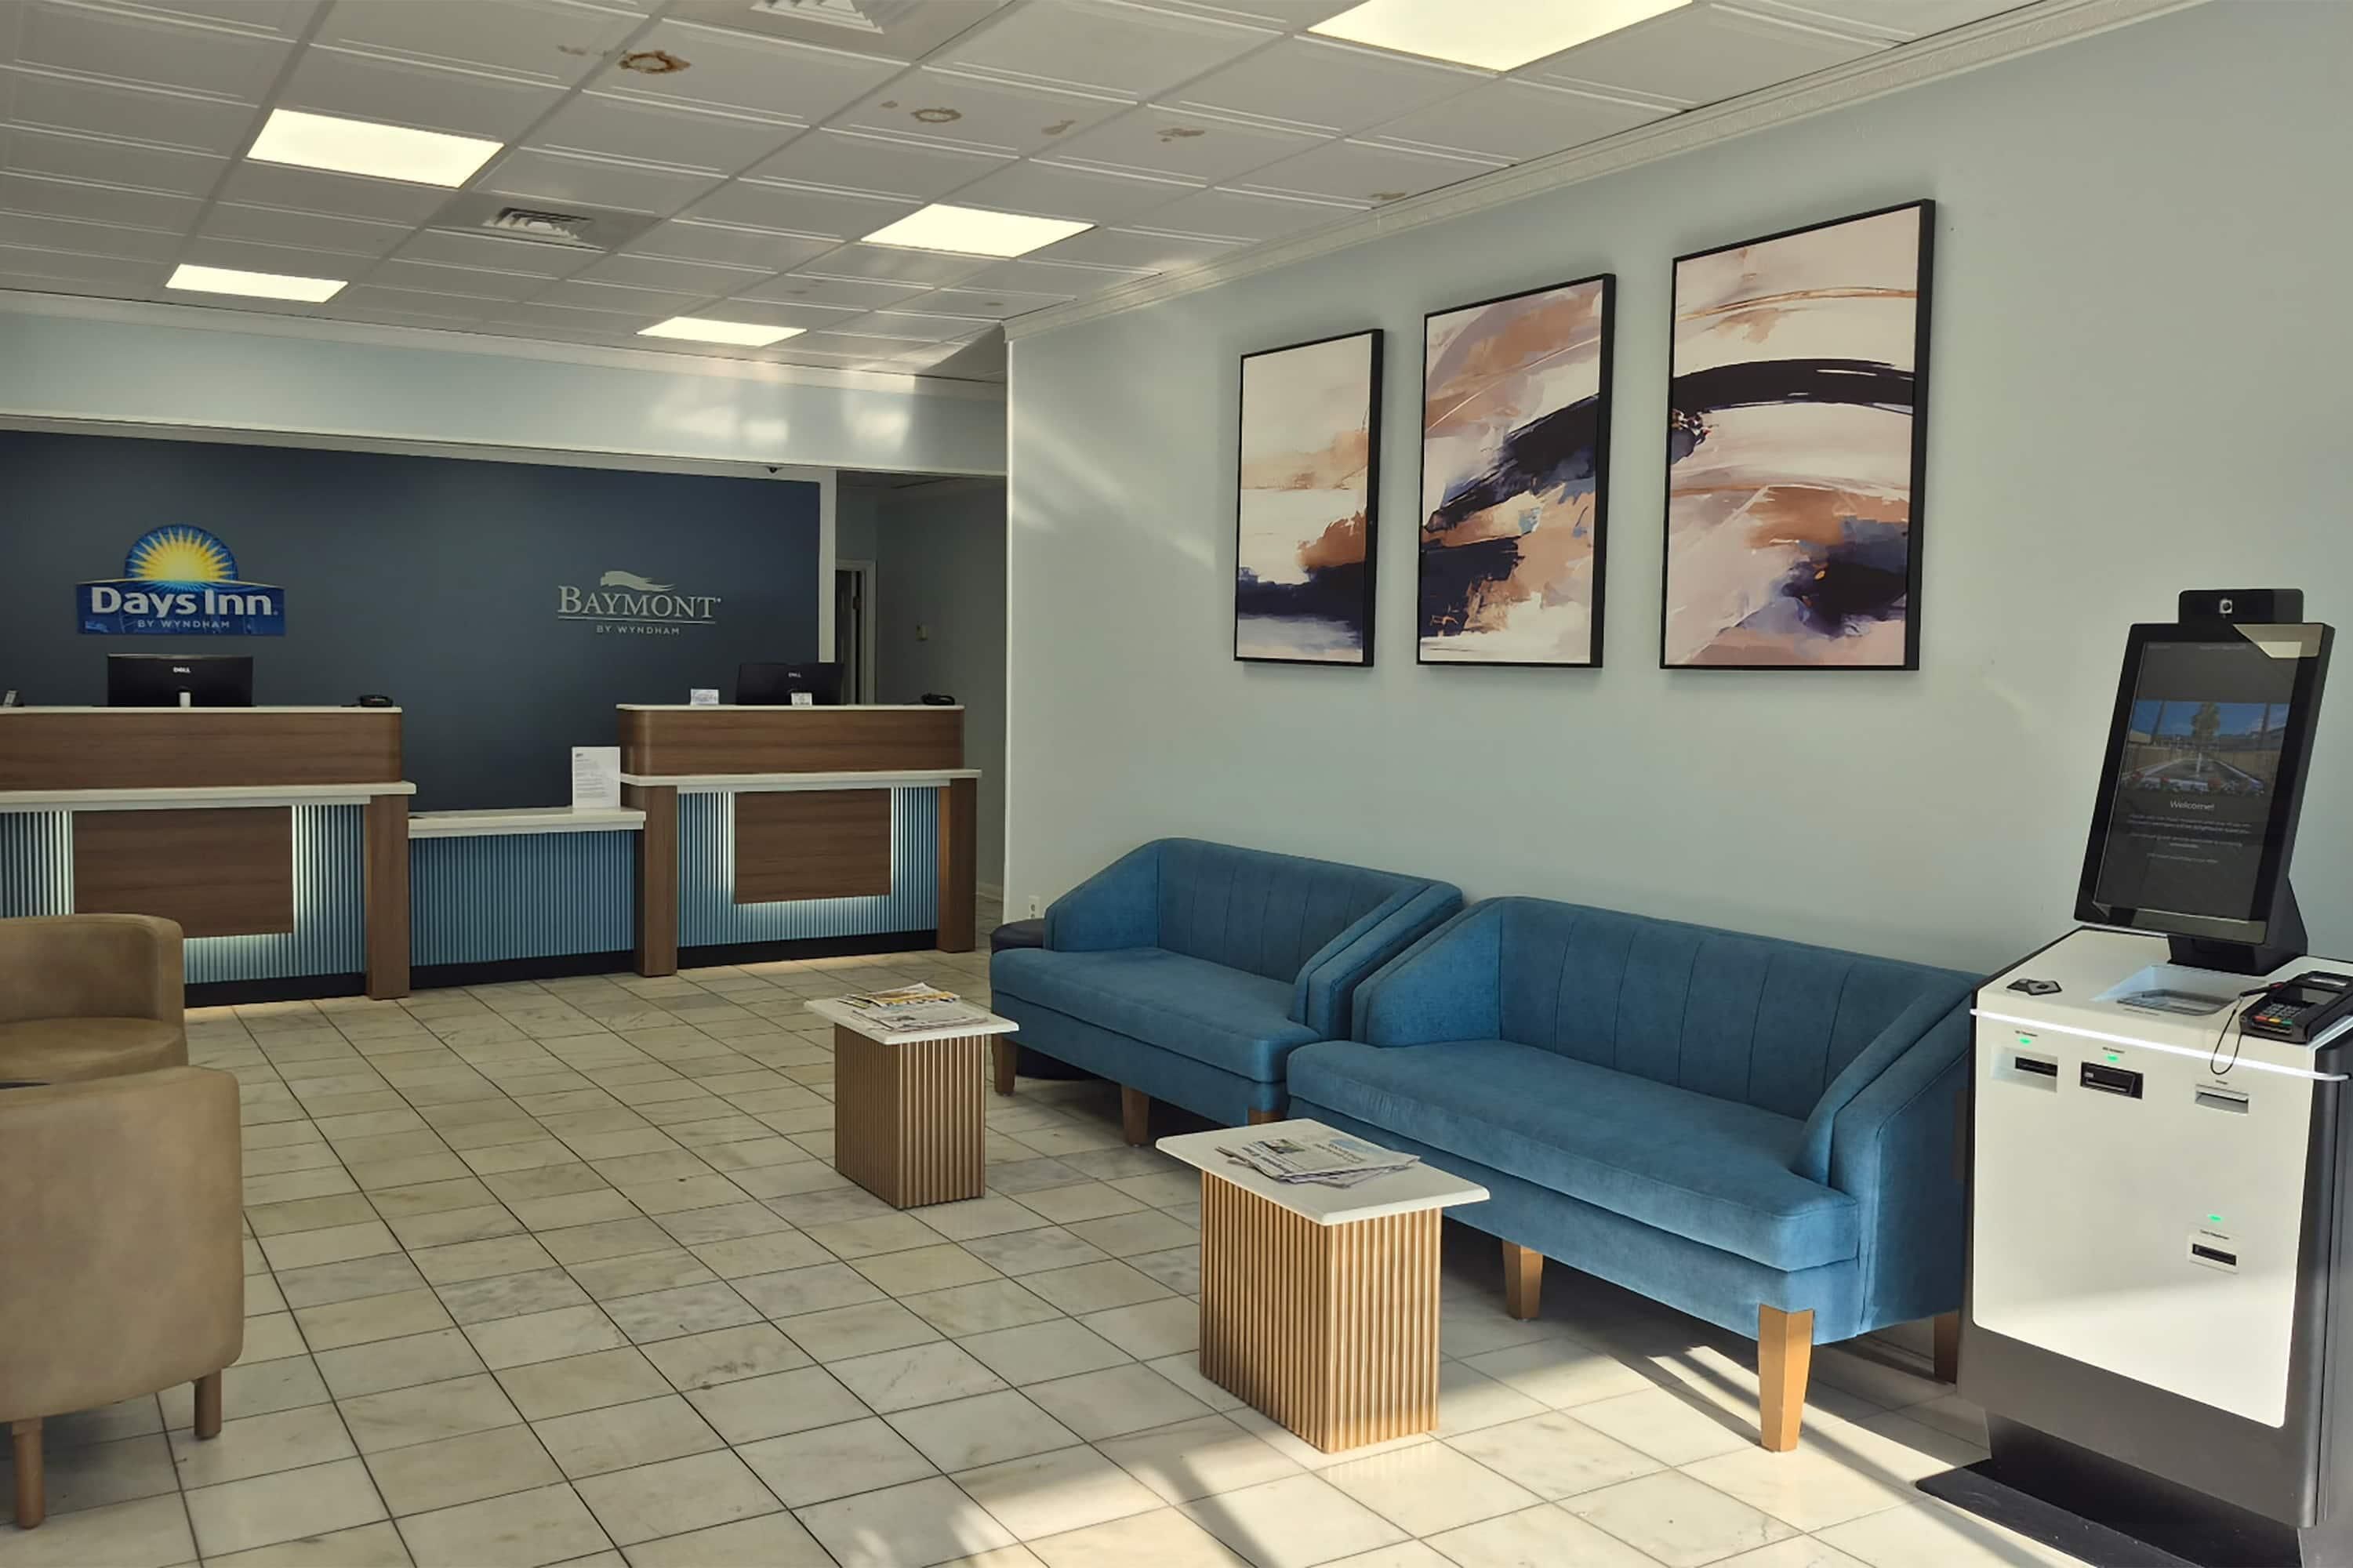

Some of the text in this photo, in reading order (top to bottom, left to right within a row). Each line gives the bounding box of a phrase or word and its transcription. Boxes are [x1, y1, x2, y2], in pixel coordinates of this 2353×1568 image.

[91, 586, 272, 618] Days Inn
[557, 585, 717, 618] BAYMONT
[137, 619, 230, 628] BY WYNDHAM
[596, 625, 680, 635] BY WYNDHAM
[2170, 800, 2215, 810] Welcome!
